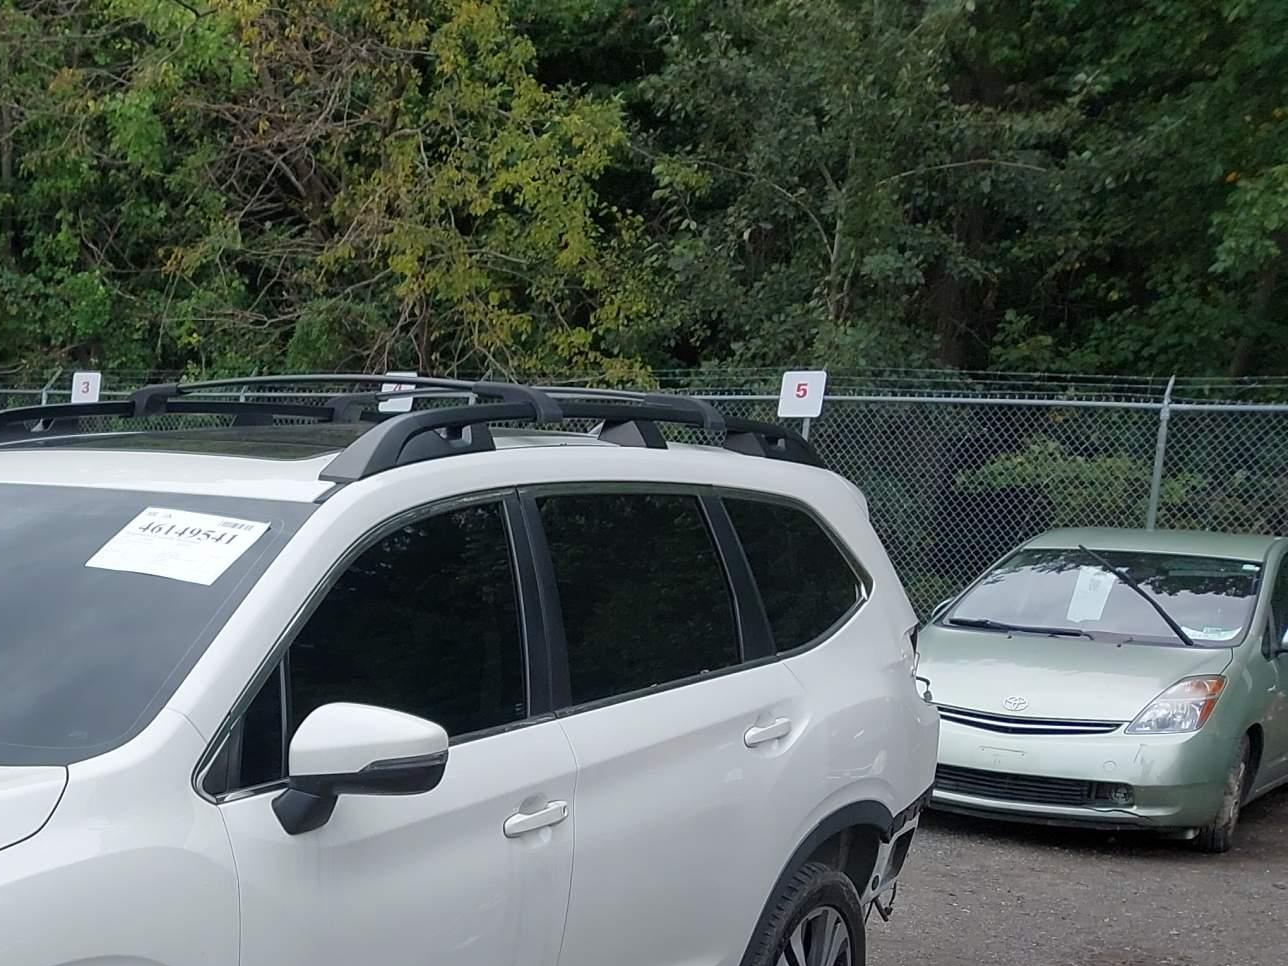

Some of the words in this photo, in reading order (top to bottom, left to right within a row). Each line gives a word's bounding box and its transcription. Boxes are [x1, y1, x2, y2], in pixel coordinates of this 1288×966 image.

[82, 381, 90, 394] 3
[795, 383, 808, 399] 5
[139, 521, 239, 545] 46149541
